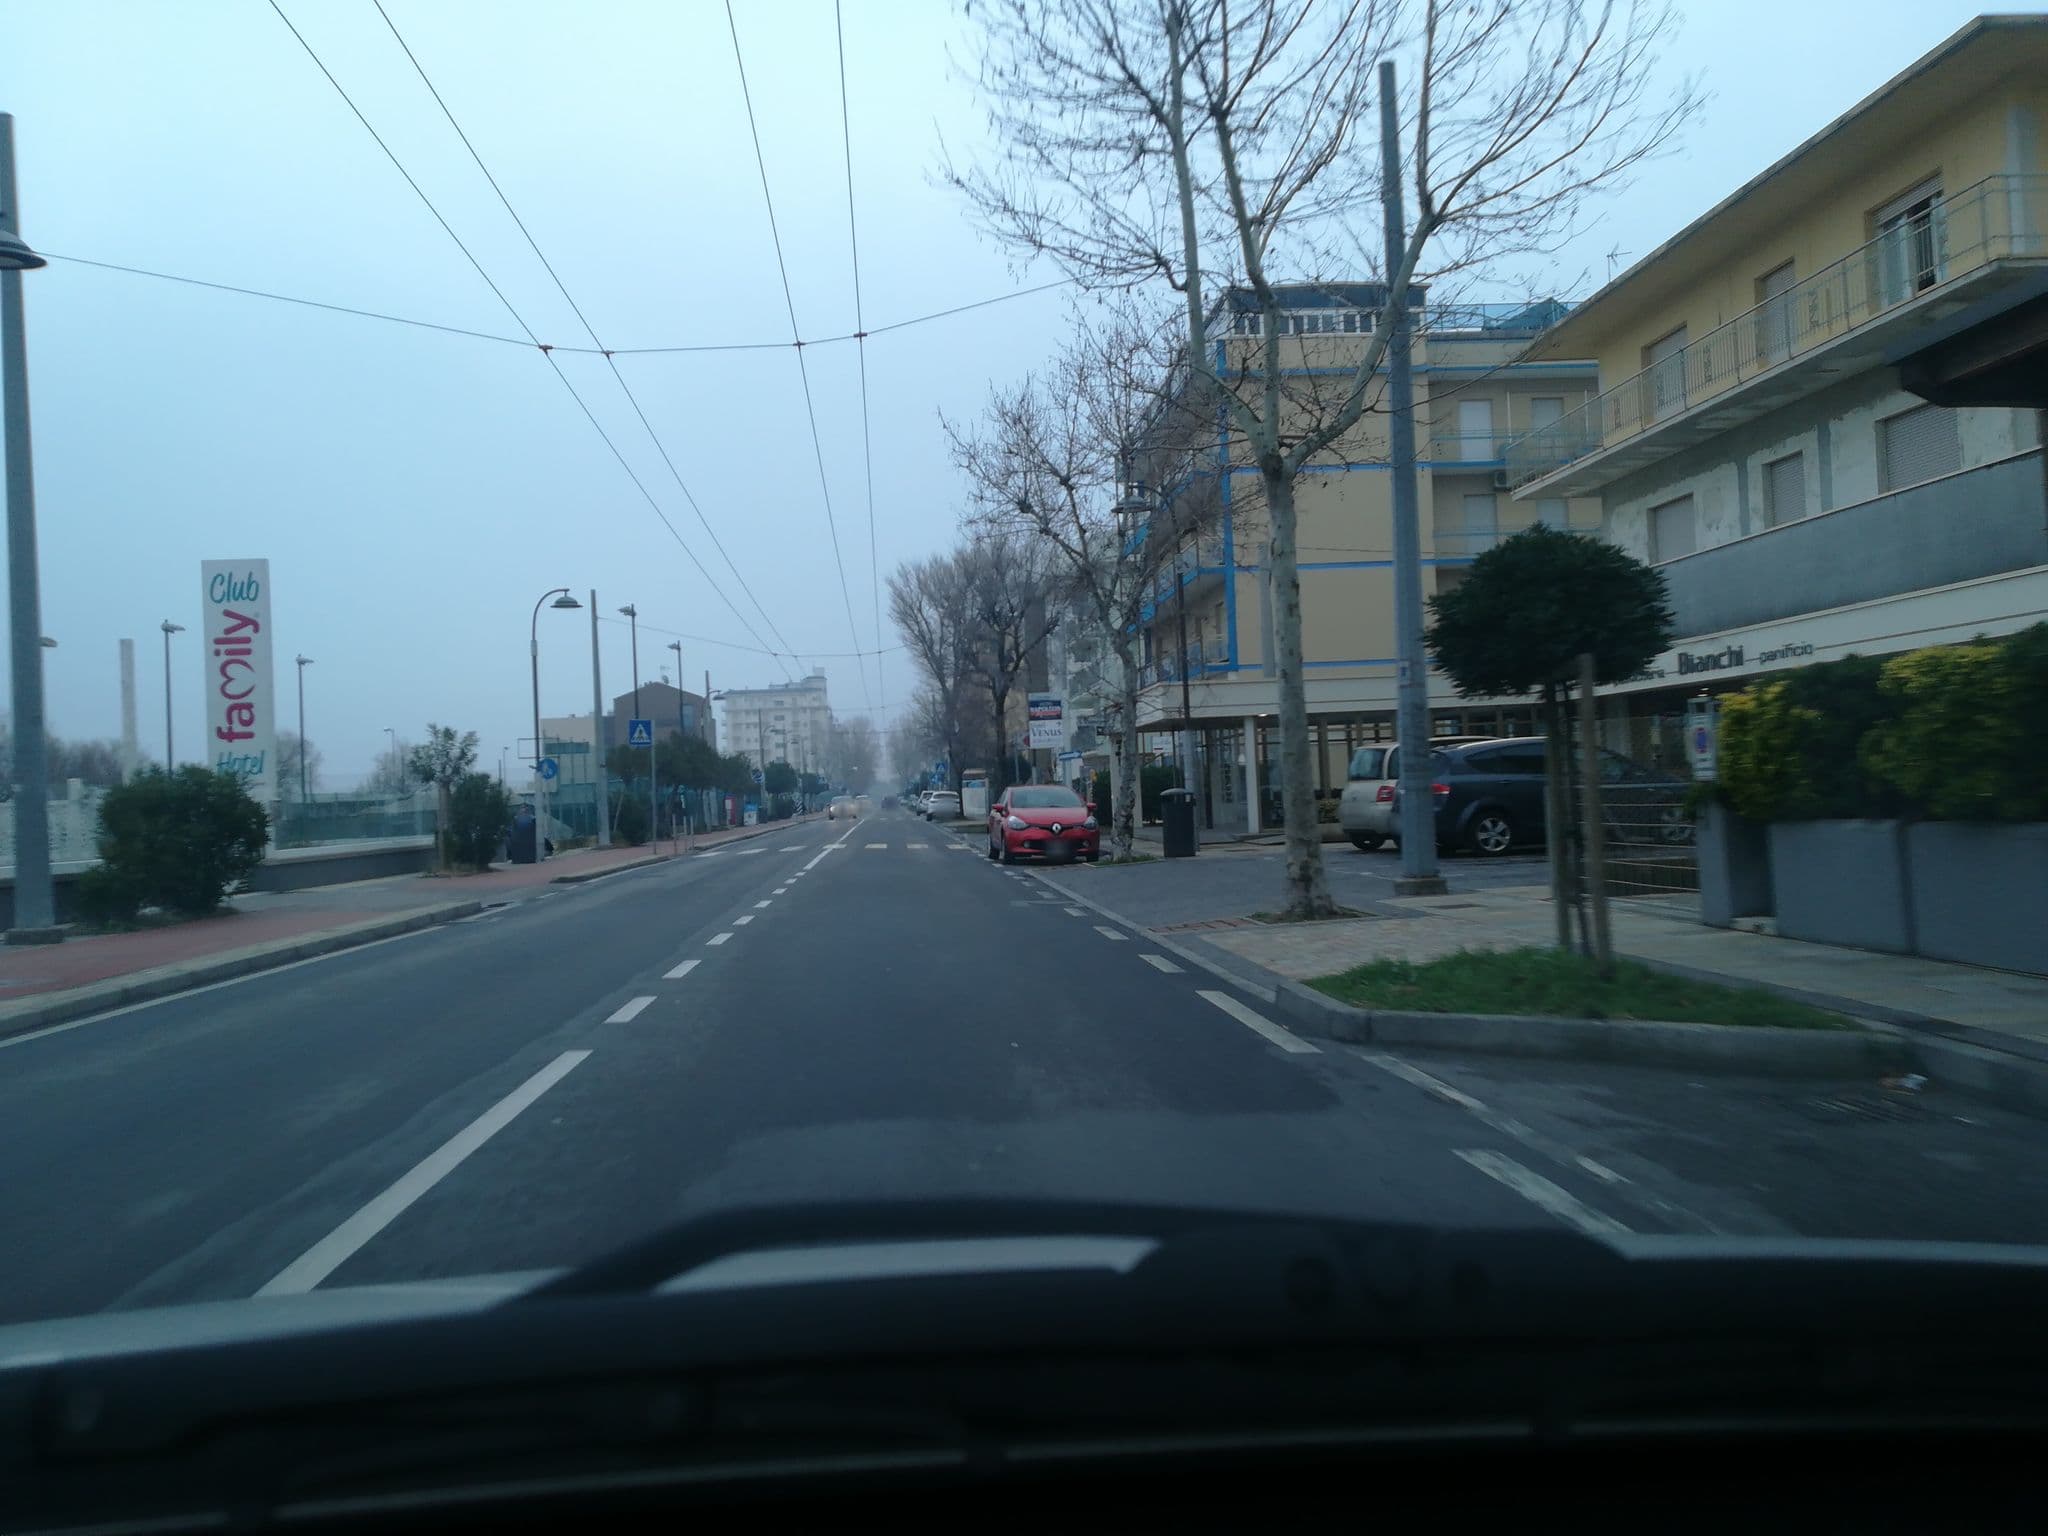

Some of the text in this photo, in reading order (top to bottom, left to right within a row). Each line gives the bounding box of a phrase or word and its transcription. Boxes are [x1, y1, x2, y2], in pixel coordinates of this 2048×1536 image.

[210, 571, 259, 604] Club
[1678, 645, 1744, 675] Bianchi
[1759, 641, 1814, 665] panificio
[213, 608, 260, 743] family
[217, 750, 265, 775] Hotel
